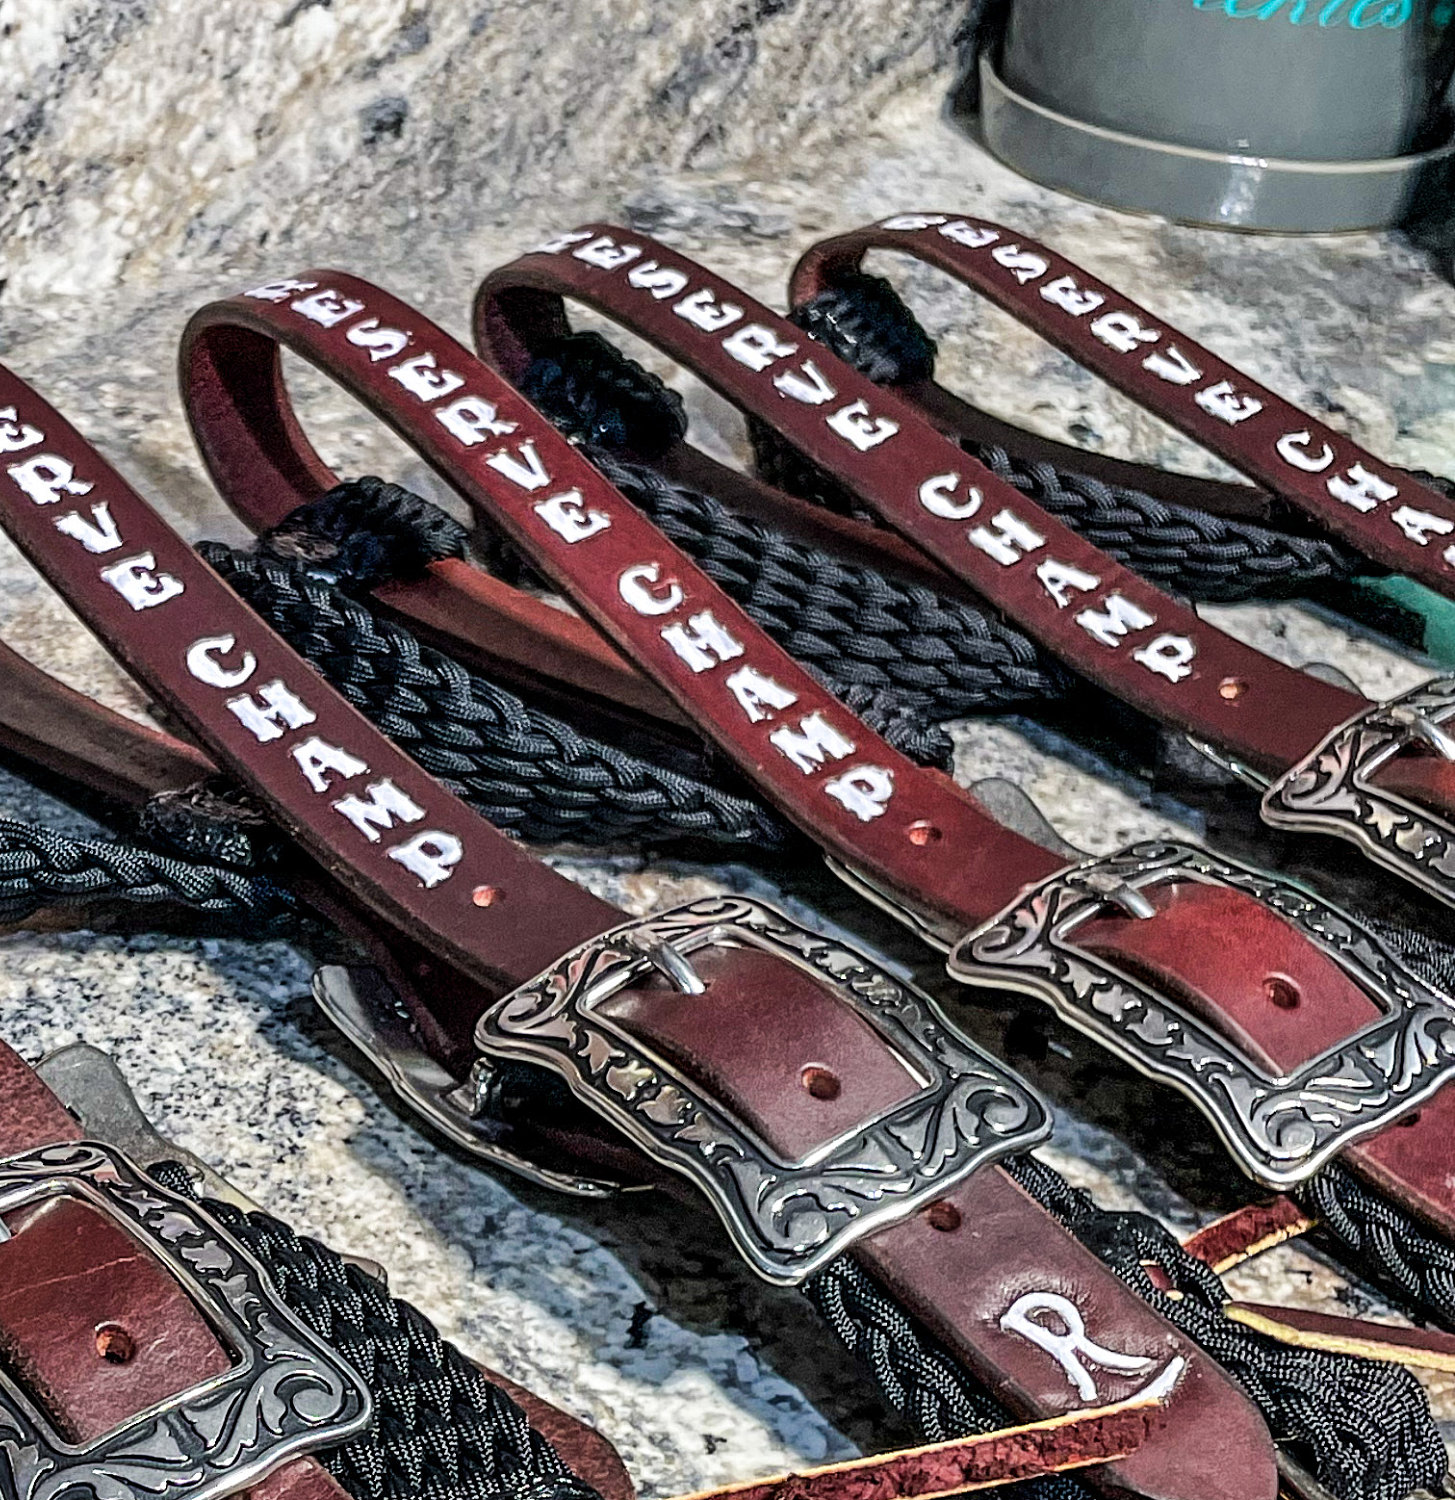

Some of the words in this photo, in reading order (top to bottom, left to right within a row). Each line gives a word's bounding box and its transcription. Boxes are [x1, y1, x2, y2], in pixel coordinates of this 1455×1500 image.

[244, 279, 611, 544] RESERVE
[619, 562, 895, 822] CHAMP
[918, 472, 1196, 683] CHAMP
[1276, 431, 1455, 568] CHA
[186, 633, 464, 889] CHAMP
